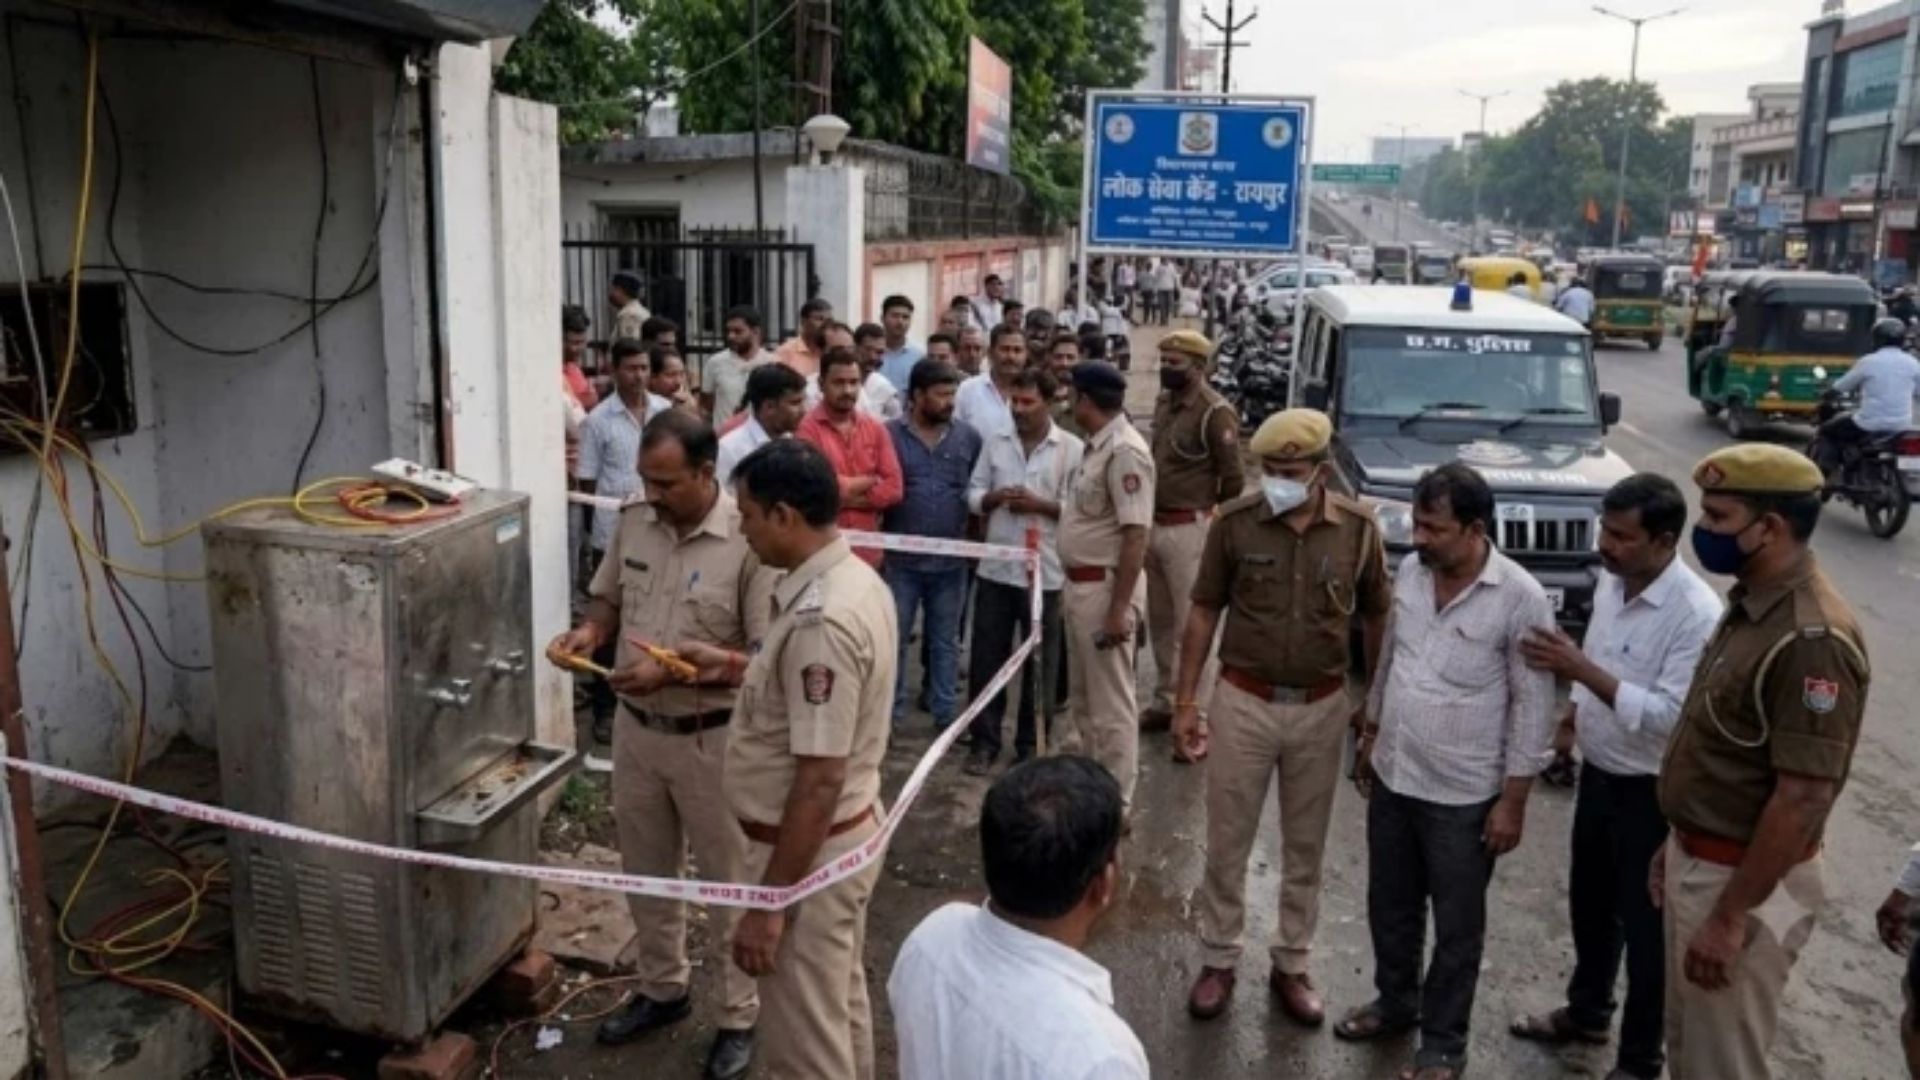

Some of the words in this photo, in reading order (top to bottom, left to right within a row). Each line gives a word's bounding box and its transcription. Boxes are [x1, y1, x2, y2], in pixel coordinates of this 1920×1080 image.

[1102, 171, 1143, 198] लोक
[1148, 173, 1182, 199] सेवा
[1234, 181, 1288, 211] रायपुर
[1465, 334, 1532, 354] पुलिस
